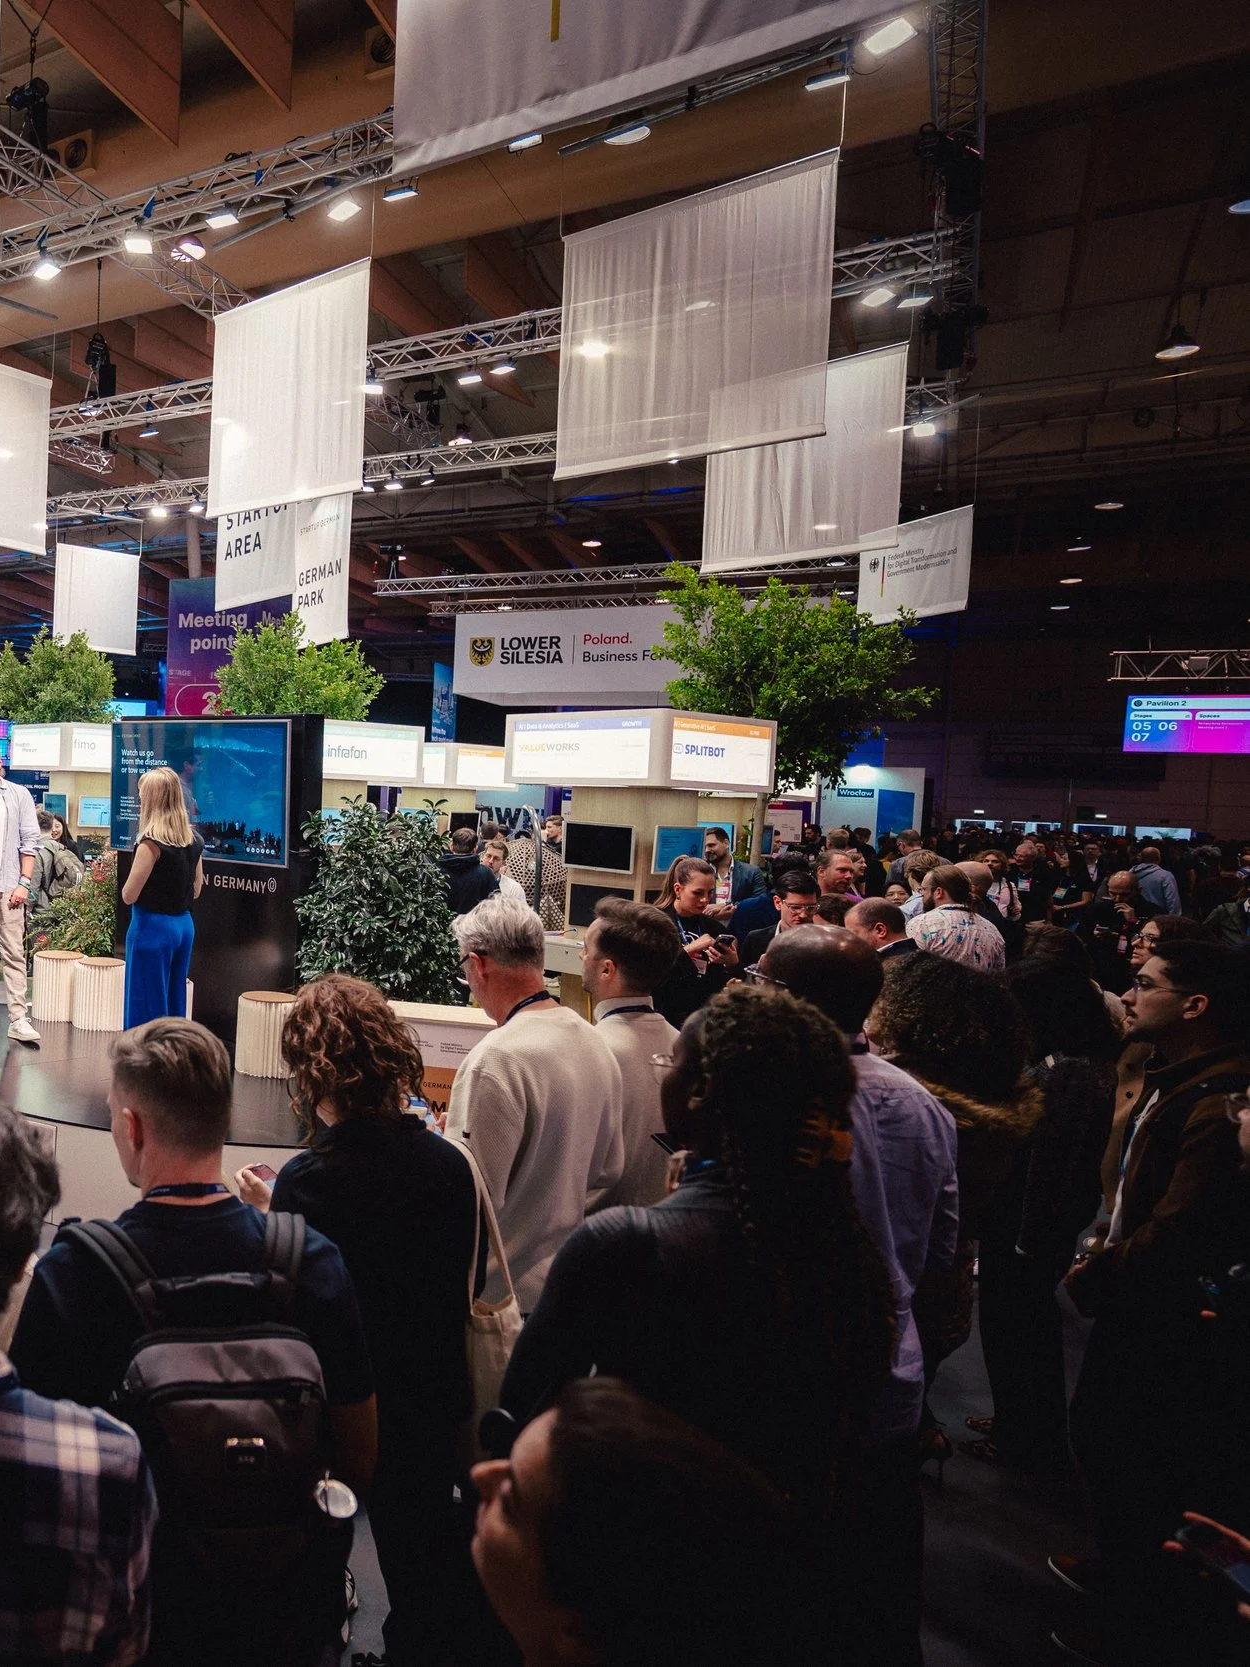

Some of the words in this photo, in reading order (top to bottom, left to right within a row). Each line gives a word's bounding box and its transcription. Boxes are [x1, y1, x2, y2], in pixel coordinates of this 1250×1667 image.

[224, 531, 262, 561] AREA
[888, 551, 905, 561] Federal
[905, 547, 925, 557] Ministry
[894, 558, 910, 569] Digital
[910, 550, 947, 566] Transformation
[947, 547, 958, 555] and
[298, 558, 342, 587] GERMAN
[887, 566, 915, 578] Government
[297, 588, 324, 609] PARK
[178, 611, 248, 629] Meeting
[190, 634, 235, 654] point
[500, 635, 561, 650] LOWER
[583, 632, 633, 645] Poland.
[500, 649, 563, 665] SILESIA
[582, 650, 638, 663] Business
[543, 723, 564, 731] Analytics
[1132, 721, 1152, 731] 05
[1158, 721, 1178, 731] 06
[1131, 732, 1150, 742] 07
[74, 739, 96, 750] fimo
[519, 743, 580, 752] VALUEWORKS
[685, 744, 726, 758] SPLITBOT
[121, 749, 138, 757] Watch
[146, 750, 155, 759] go
[327, 745, 367, 760] infrafon
[121, 757, 134, 765] from
[145, 758, 168, 766] distance
[839, 788, 873, 796] Wrocław
[213, 875, 267, 894] GERMANY
[422, 1081, 452, 1091] GERMAN
